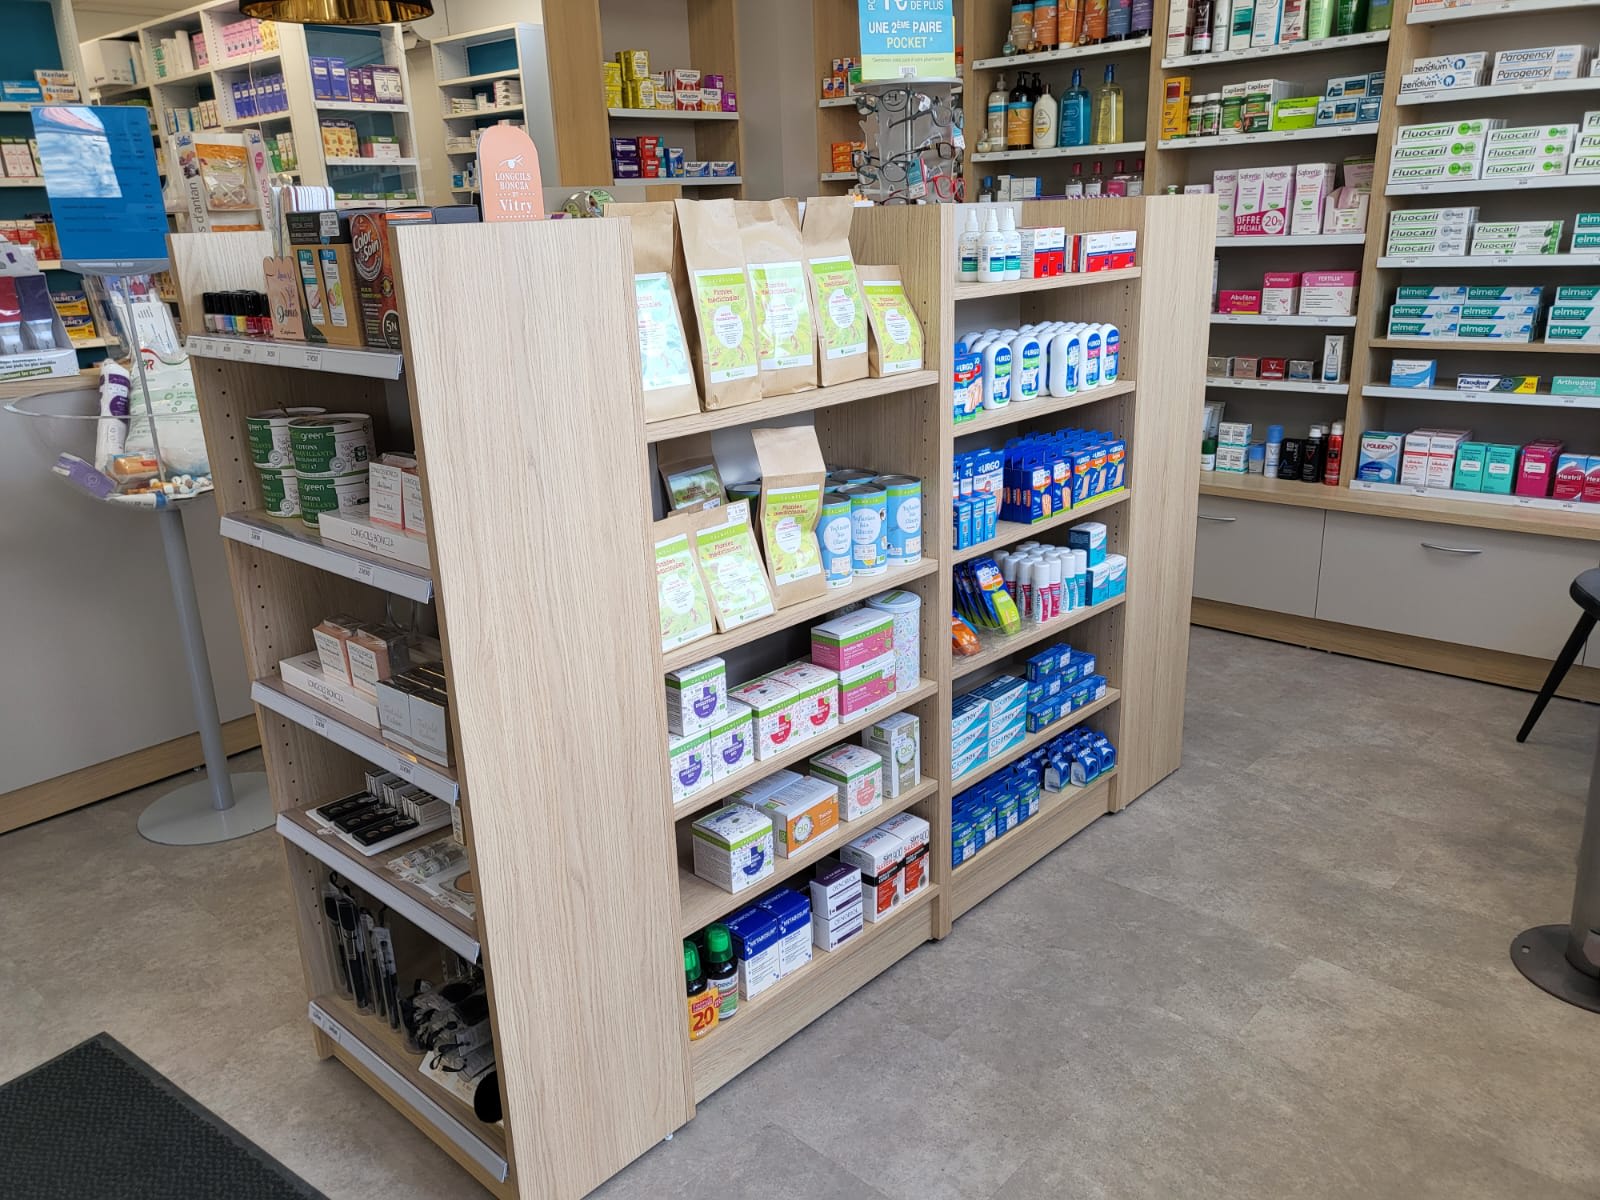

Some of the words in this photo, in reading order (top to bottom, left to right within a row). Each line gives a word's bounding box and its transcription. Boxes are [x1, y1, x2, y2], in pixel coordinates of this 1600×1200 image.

[911, 1, 922, 10] DE
[924, 0, 944, 10] PLUS
[868, 22, 889, 34] UNE
[913, 22, 942, 33] PAIRE
[886, 37, 927, 48] POCKET
[1500, 49, 1555, 62] Parogencyl
[1414, 62, 1447, 72] zendium
[1497, 67, 1552, 79] Parogencyl
[1403, 78, 1437, 89] zendium
[1401, 126, 1454, 139] Fluocaril
[1491, 130, 1540, 141] Fluocaril
[1394, 146, 1447, 158] Fluocaril
[1488, 147, 1536, 157] Fluocaril
[1392, 166, 1445, 177] Fluocaril
[1486, 164, 1534, 173] Fluocaril
[495, 172, 530, 180] LONGCILS
[500, 199, 532, 213] Vitry
[1236, 216, 1260, 225] OFFRE
[1392, 213, 1439, 221] Fluocaril
[1236, 224, 1261, 232] SPÉCIALE
[1477, 225, 1520, 233] Fluocaril
[1390, 229, 1437, 237] Fluocaril
[353, 230, 371, 252] Color
[1474, 241, 1517, 249] Fluocaril
[364, 239, 379, 261] Soin
[1389, 244, 1434, 252] Fluocaril
[1470, 288, 1500, 296] elmex
[1561, 288, 1593, 296] elmex
[1554, 308, 1586, 316] elmex
[1551, 327, 1583, 335] elmex
[959, 363, 974, 371] URGO
[302, 432, 324, 441] green
[1112, 445, 1124, 453] URGO
[1094, 450, 1106, 459] URGO
[981, 460, 1000, 472] URGO
[304, 483, 324, 492] green
[693, 1006, 714, 1031] 20
